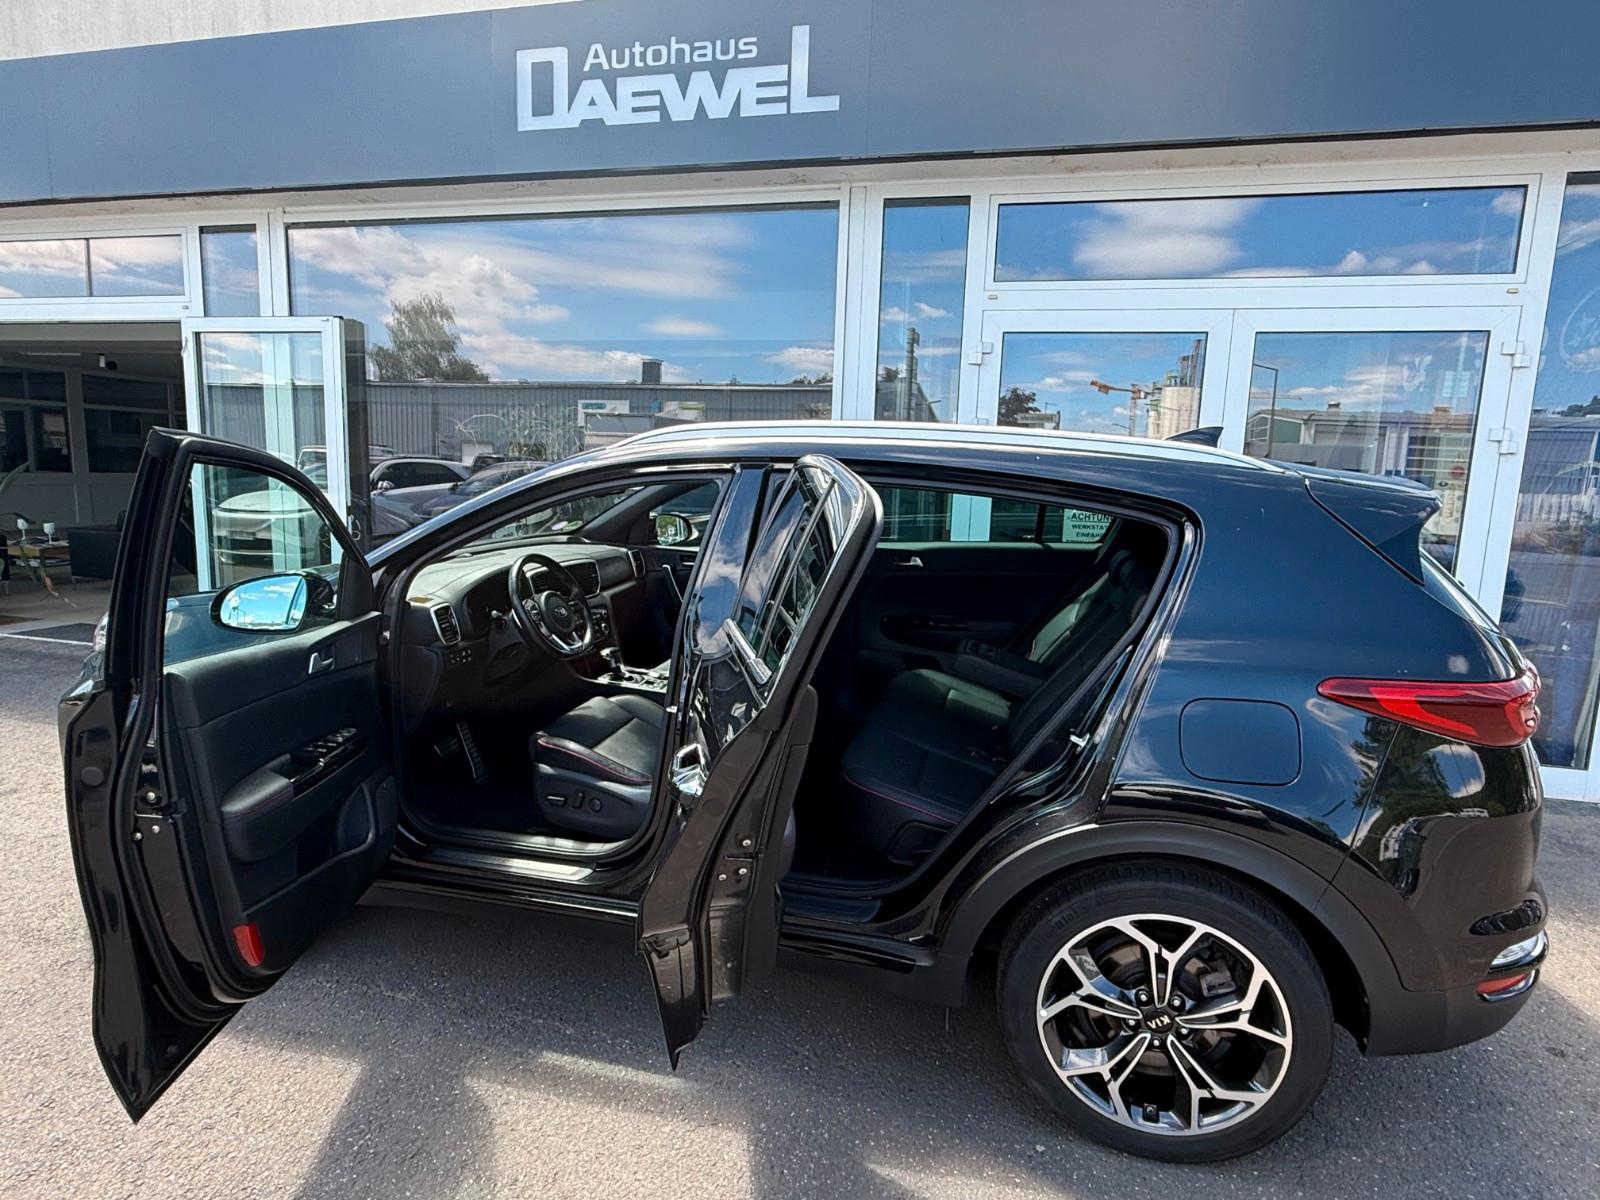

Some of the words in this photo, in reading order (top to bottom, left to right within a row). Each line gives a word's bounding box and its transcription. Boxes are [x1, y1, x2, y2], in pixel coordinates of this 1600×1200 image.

[583, 36, 758, 71] Autohaus
[516, 25, 840, 131] DAEWEL
[1071, 512, 1112, 521] ACHTUN
[1146, 1014, 1171, 1029] KIA
